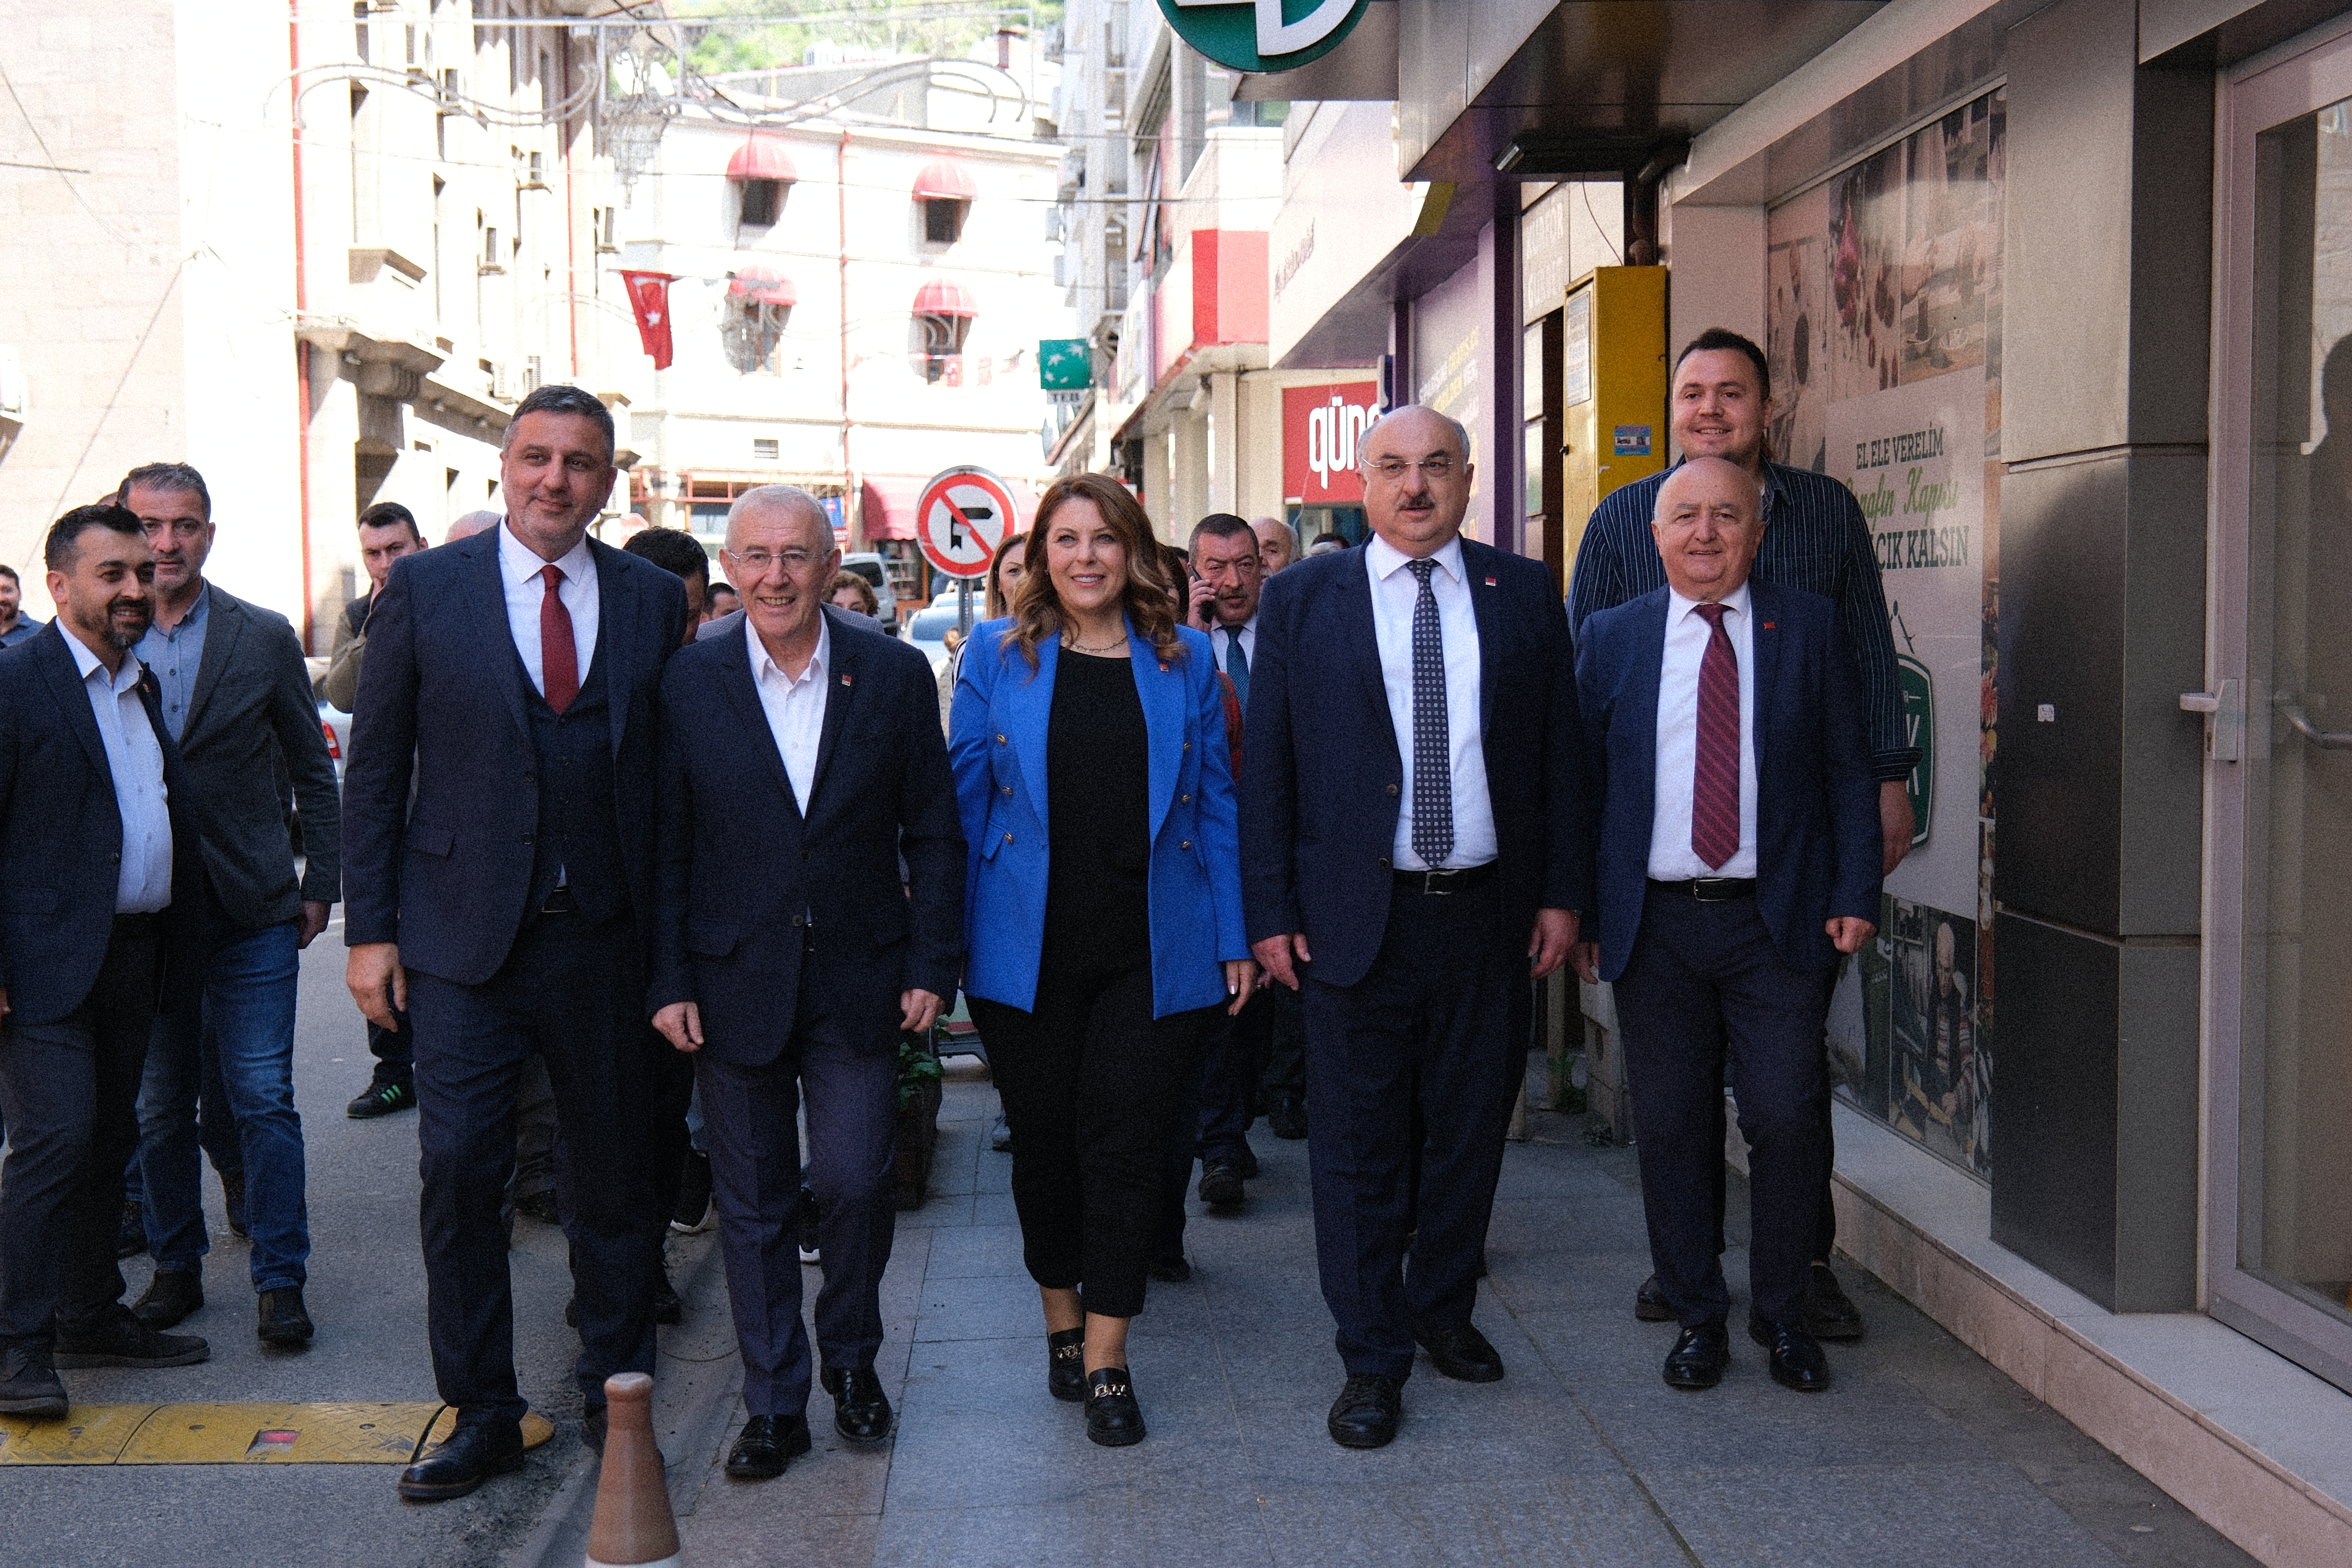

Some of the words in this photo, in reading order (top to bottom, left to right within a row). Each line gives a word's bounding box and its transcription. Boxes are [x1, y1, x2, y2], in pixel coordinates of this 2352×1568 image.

[1309, 396, 1385, 490] gün
[1856, 443, 1868, 470] EL
[1871, 438, 1890, 468] ELE
[1892, 421, 1943, 463] VERELİM
[1870, 531, 1903, 579] ÇIK
[1906, 525, 1969, 568] KALSIN
